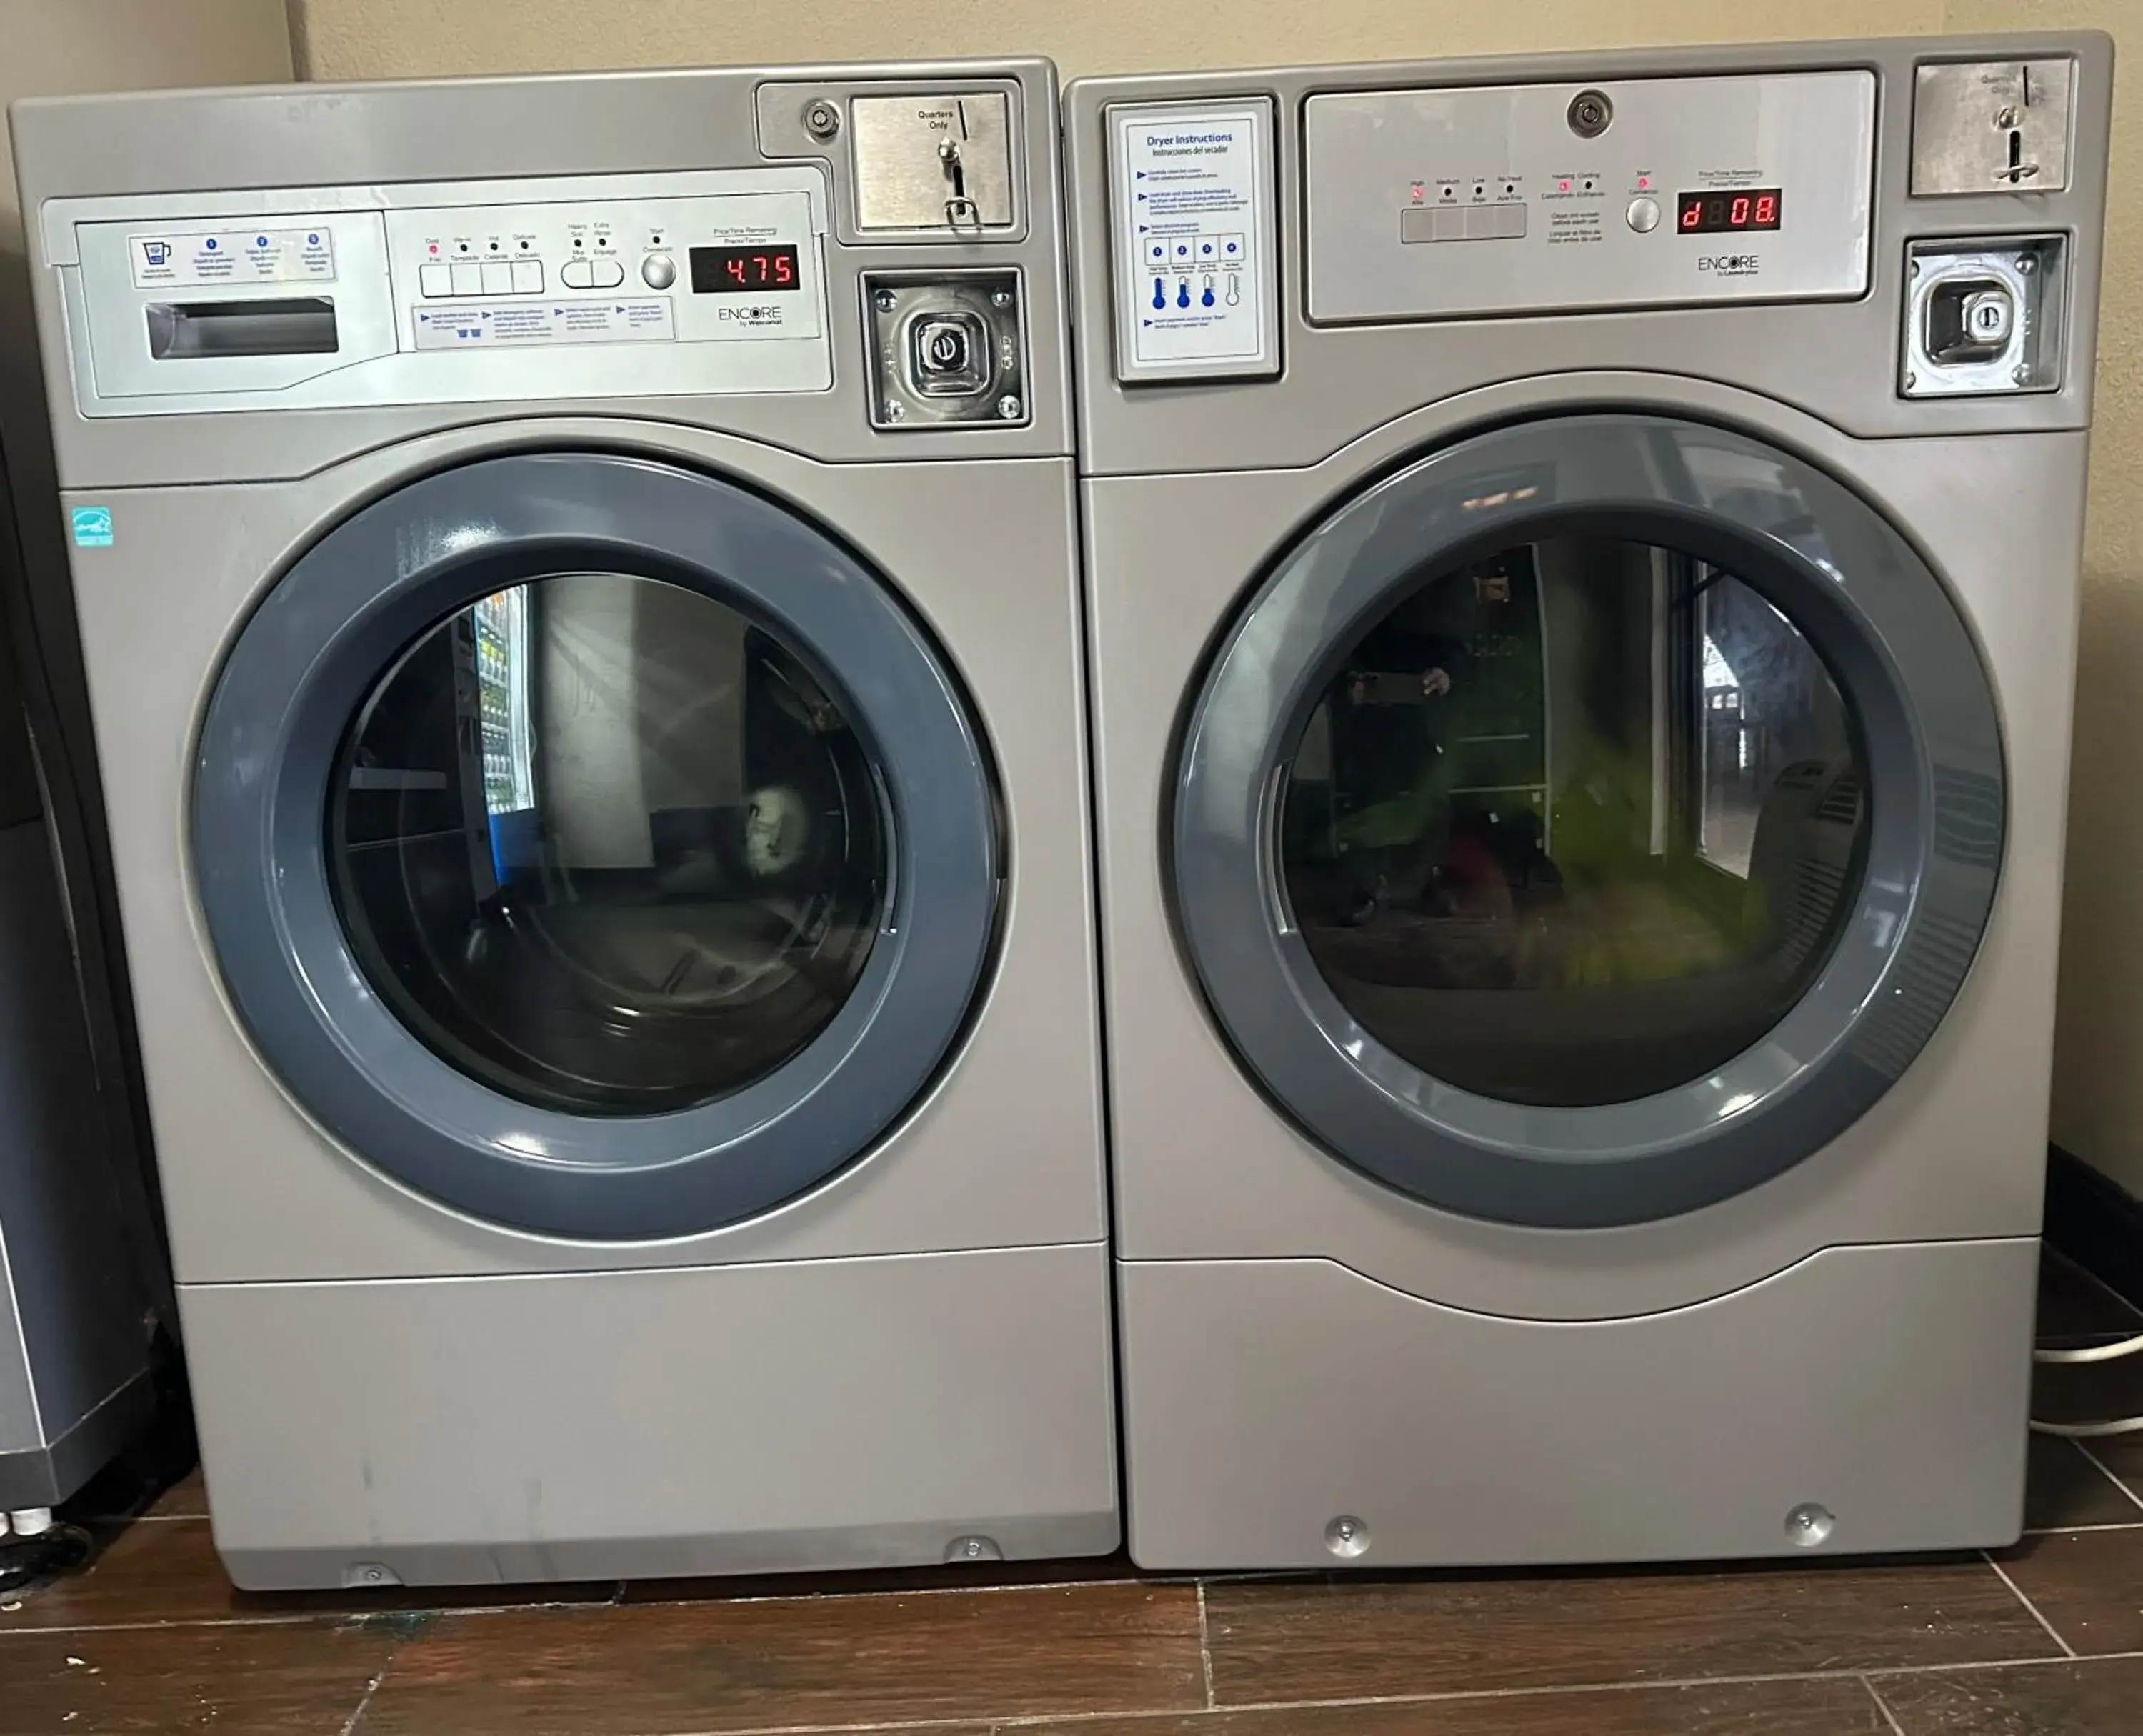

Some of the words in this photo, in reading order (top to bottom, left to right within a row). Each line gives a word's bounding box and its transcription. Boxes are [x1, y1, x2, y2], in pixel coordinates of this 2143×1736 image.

[918, 110, 954, 119] Quarters
[929, 121, 949, 131] Only
[1147, 136, 1174, 147] Dryer
[1175, 134, 1233, 144] Instructions
[1152, 147, 1192, 156] Instrucciones
[1192, 146, 1204, 154] del
[1698, 255, 1759, 271] ENCORE
[718, 306, 783, 321] ENCORE
